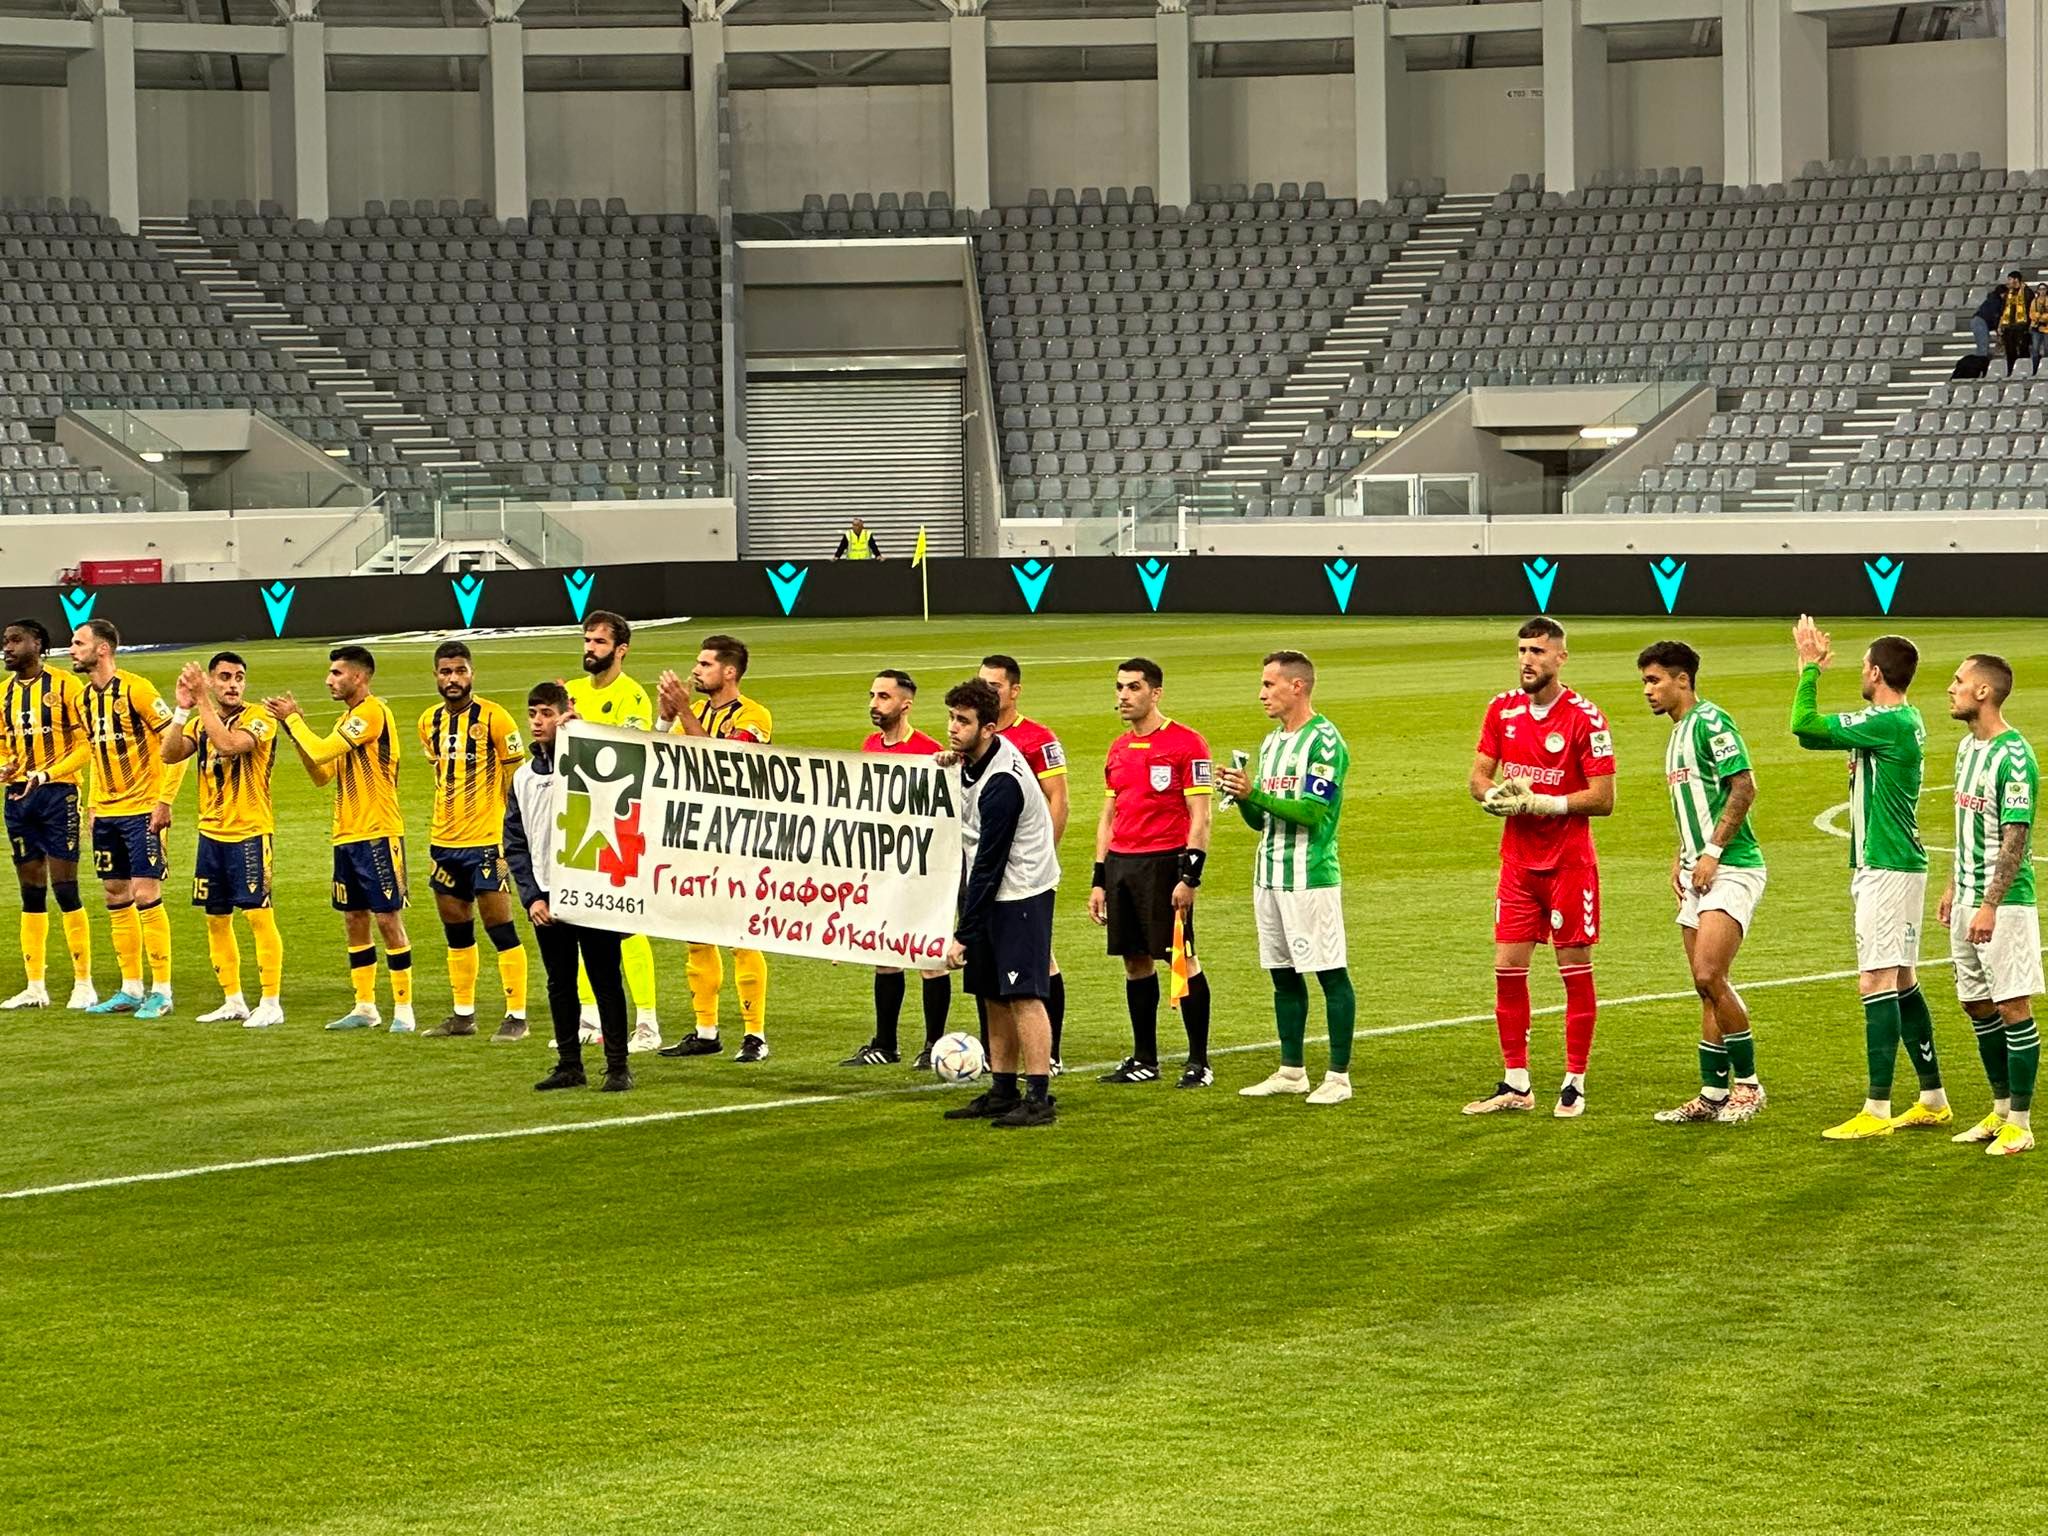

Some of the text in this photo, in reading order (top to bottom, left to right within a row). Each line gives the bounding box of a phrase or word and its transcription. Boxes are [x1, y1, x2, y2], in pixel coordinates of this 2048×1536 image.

[652, 741, 955, 818] ΣΥΝΔΕΣΜΟΣ ΓΙΑ ΑΤΟΜΑ
[1312, 778, 1328, 796] C
[1503, 762, 1565, 786] FONBET
[662, 800, 934, 876] ΜΕ ΑΥΤΙΣΜΟ ΚΥΠΡΟΥ
[95, 850, 113, 872] 23
[193, 877, 209, 900] 15
[653, 863, 869, 914] Γιατί η διαφορά
[559, 889, 645, 915] 25 343461
[748, 906, 945, 963] είναι δικαίωμα
